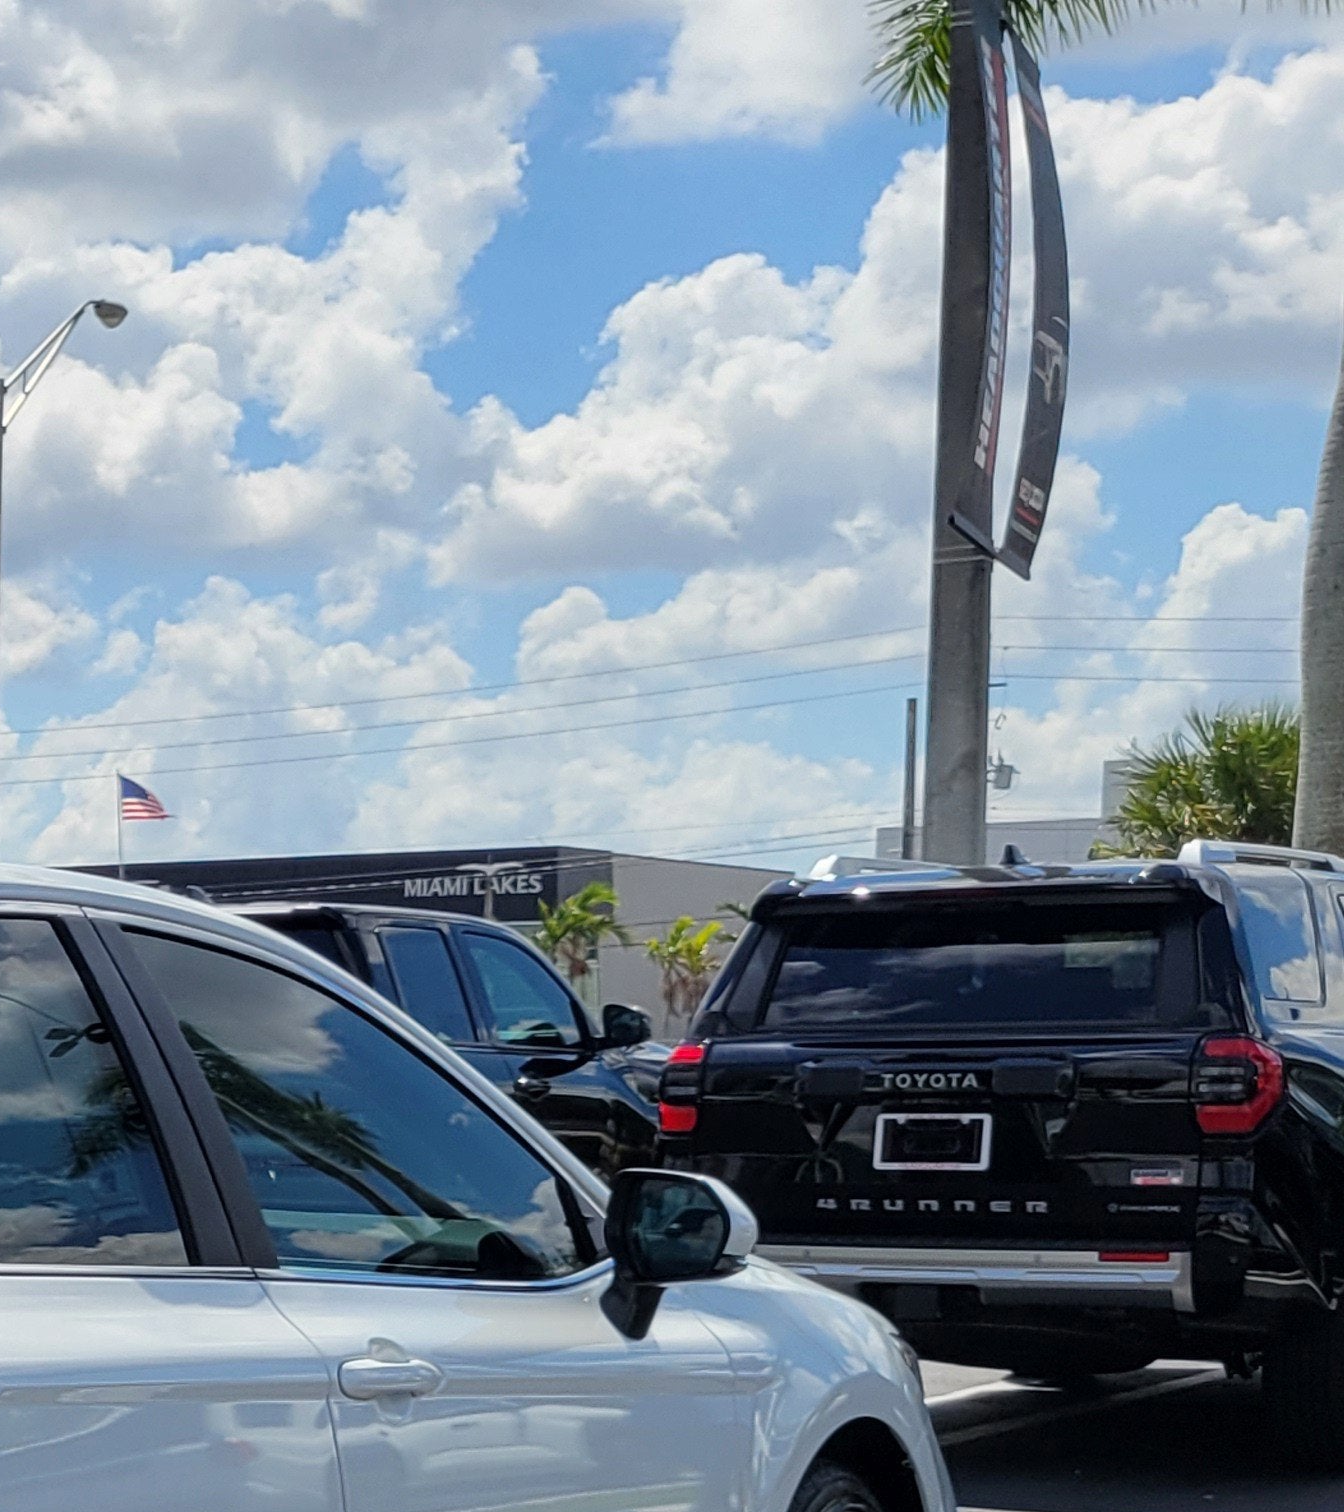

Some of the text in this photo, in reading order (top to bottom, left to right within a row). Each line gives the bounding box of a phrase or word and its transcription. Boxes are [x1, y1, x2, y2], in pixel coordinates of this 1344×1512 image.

[403, 874, 544, 898] MIAMI LAKES
[880, 1072, 979, 1089] TOYOTA
[815, 1197, 1050, 1214] 4RUNNER
